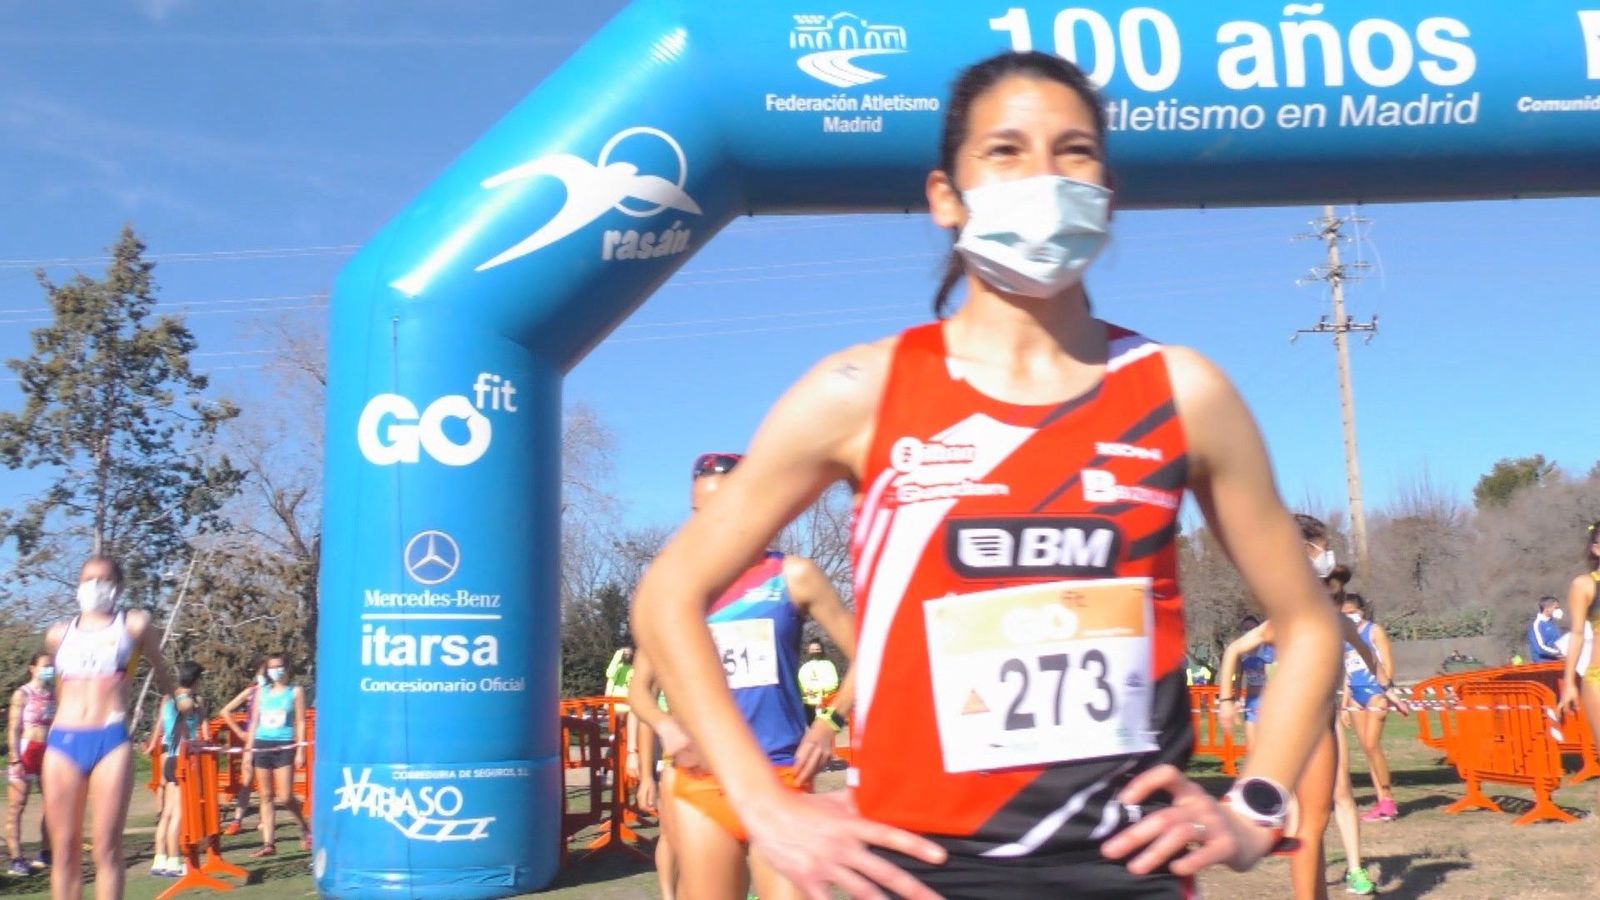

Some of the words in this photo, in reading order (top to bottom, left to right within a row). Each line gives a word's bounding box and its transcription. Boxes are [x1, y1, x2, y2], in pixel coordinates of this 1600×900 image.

[989, 7, 1181, 91] 100
[1216, 3, 1477, 90] años
[765, 94, 858, 111] Federación
[861, 94, 940, 111] Atletismo
[1105, 98, 1264, 131] tletismo
[1277, 101, 1327, 128] en
[1339, 92, 1480, 127] Madrid
[823, 116, 883, 133] Madrid
[601, 220, 691, 262] rasán
[473, 373, 518, 412] fit
[357, 393, 493, 467] GO
[1018, 527, 1114, 568] BM
[364, 589, 502, 608] Mercedes-Benz
[361, 623, 499, 667] itarsa
[360, 677, 477, 693] Concesionario
[479, 677, 525, 692] Oficial
[1000, 649, 1115, 731] 273
